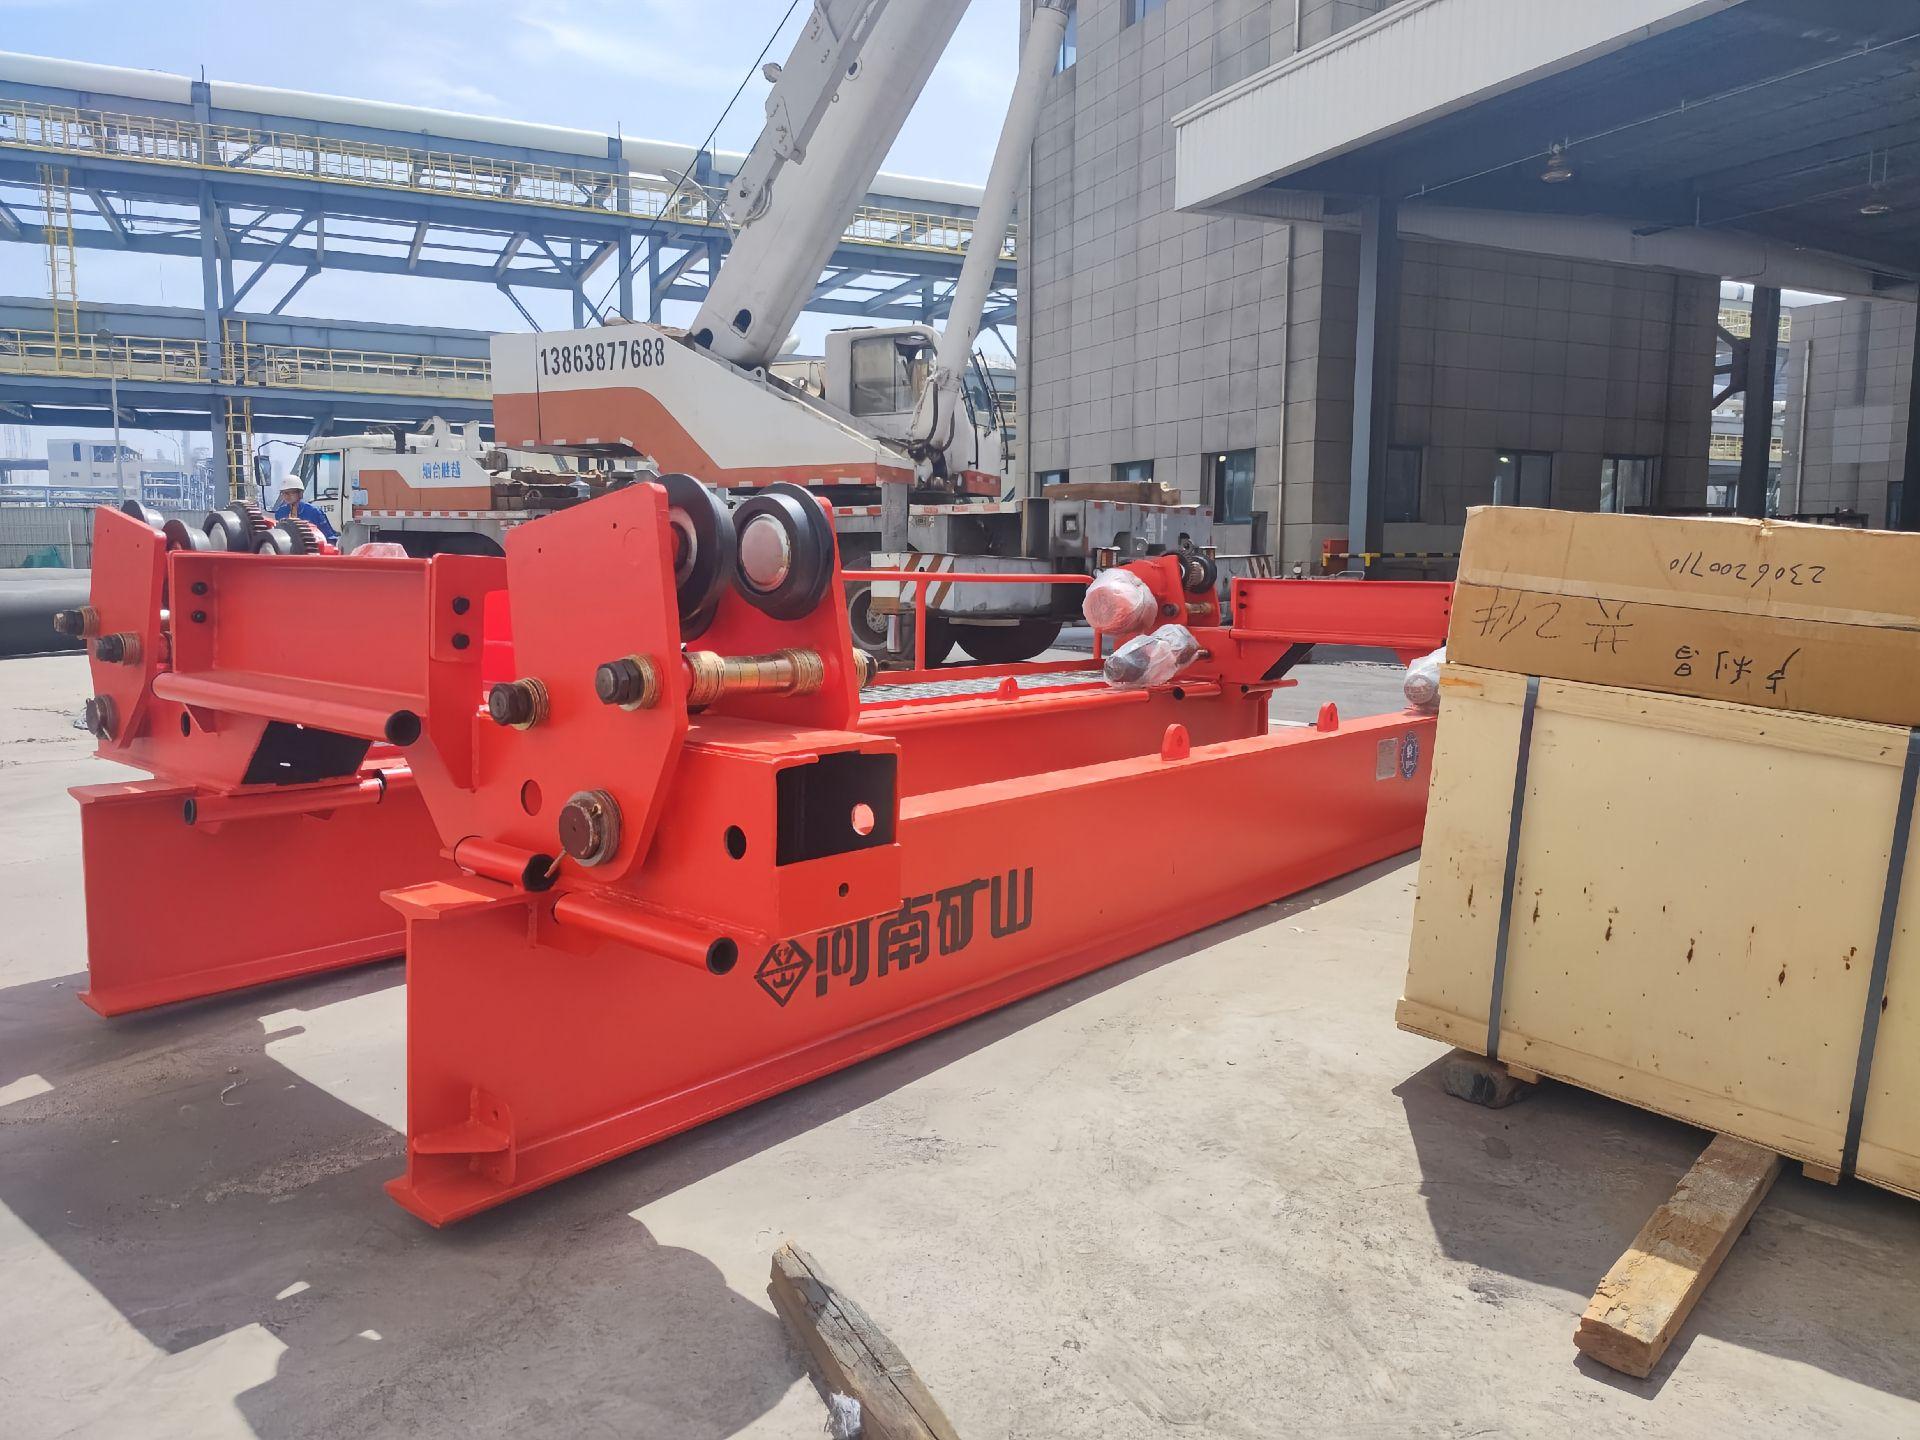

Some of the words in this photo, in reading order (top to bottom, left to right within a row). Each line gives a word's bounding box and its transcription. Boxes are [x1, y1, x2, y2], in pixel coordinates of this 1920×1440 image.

[540, 337, 665, 376] 13863877688
[1669, 552, 1825, 589] 2306200710
[815, 867, 1034, 998] 河南矿山
